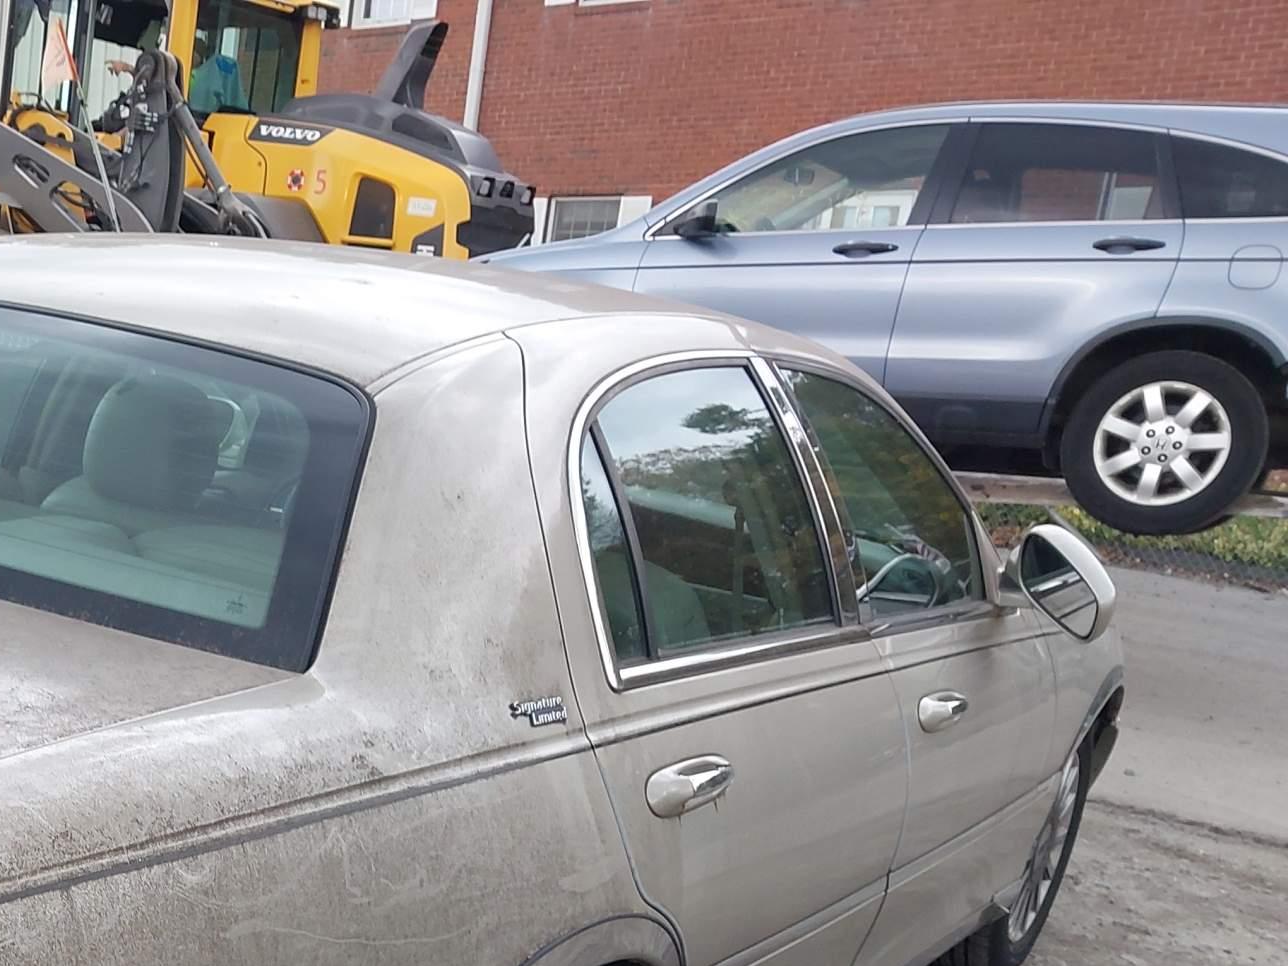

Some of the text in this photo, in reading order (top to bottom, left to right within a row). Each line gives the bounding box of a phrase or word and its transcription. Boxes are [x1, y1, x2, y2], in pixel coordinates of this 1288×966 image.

[259, 124, 321, 141] VOLVO
[313, 169, 327, 194] 5
[513, 695, 563, 715] Signature
[531, 706, 568, 725] Limited
